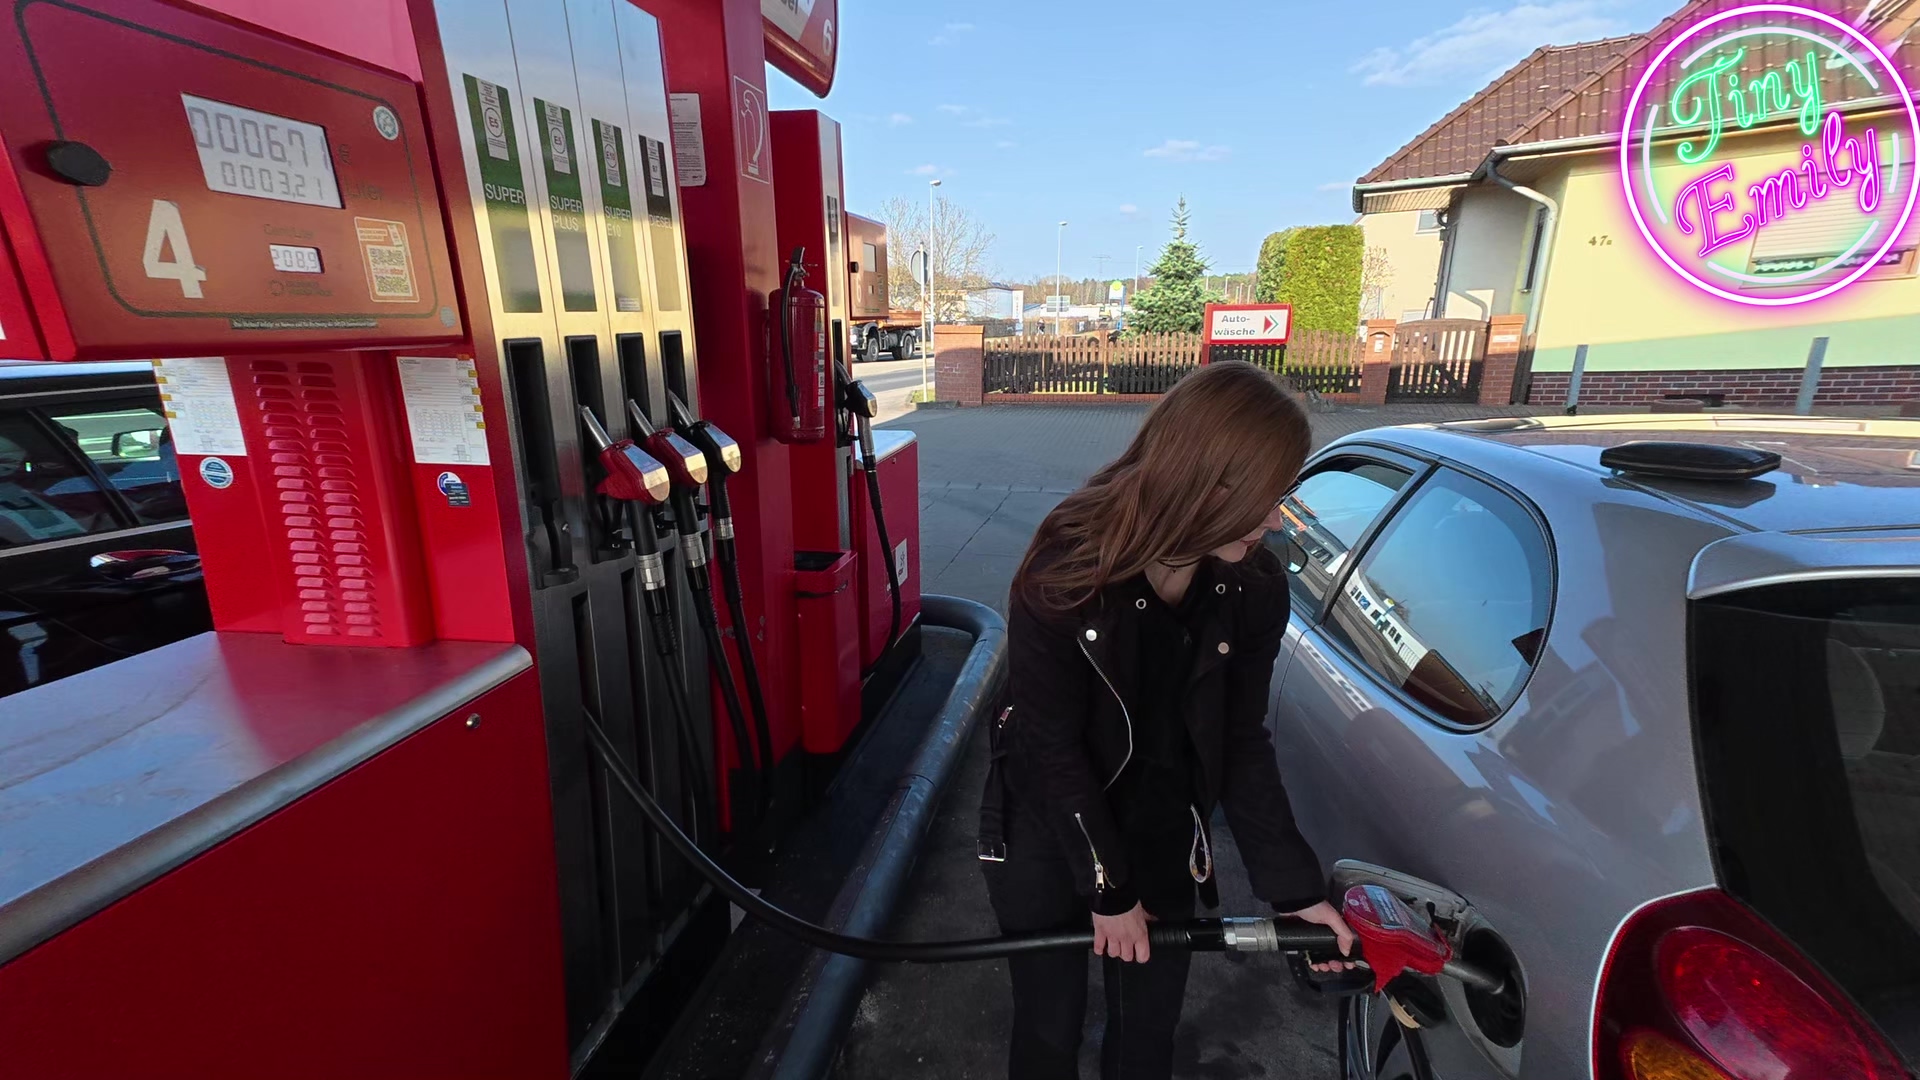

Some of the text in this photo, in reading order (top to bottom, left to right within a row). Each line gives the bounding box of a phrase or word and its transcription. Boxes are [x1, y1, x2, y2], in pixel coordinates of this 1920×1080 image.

[822, 18, 833, 57] 6
[489, 116, 500, 129] E5
[484, 183, 526, 205] SUPER
[550, 195, 584, 213] SUPER
[604, 205, 632, 221] SUPER
[552, 215, 579, 231] PLUS
[607, 223, 622, 237] E10
[143, 199, 207, 298] 4
[1221, 315, 1250, 323] Auto-
[1214, 327, 1256, 336] wäsche
